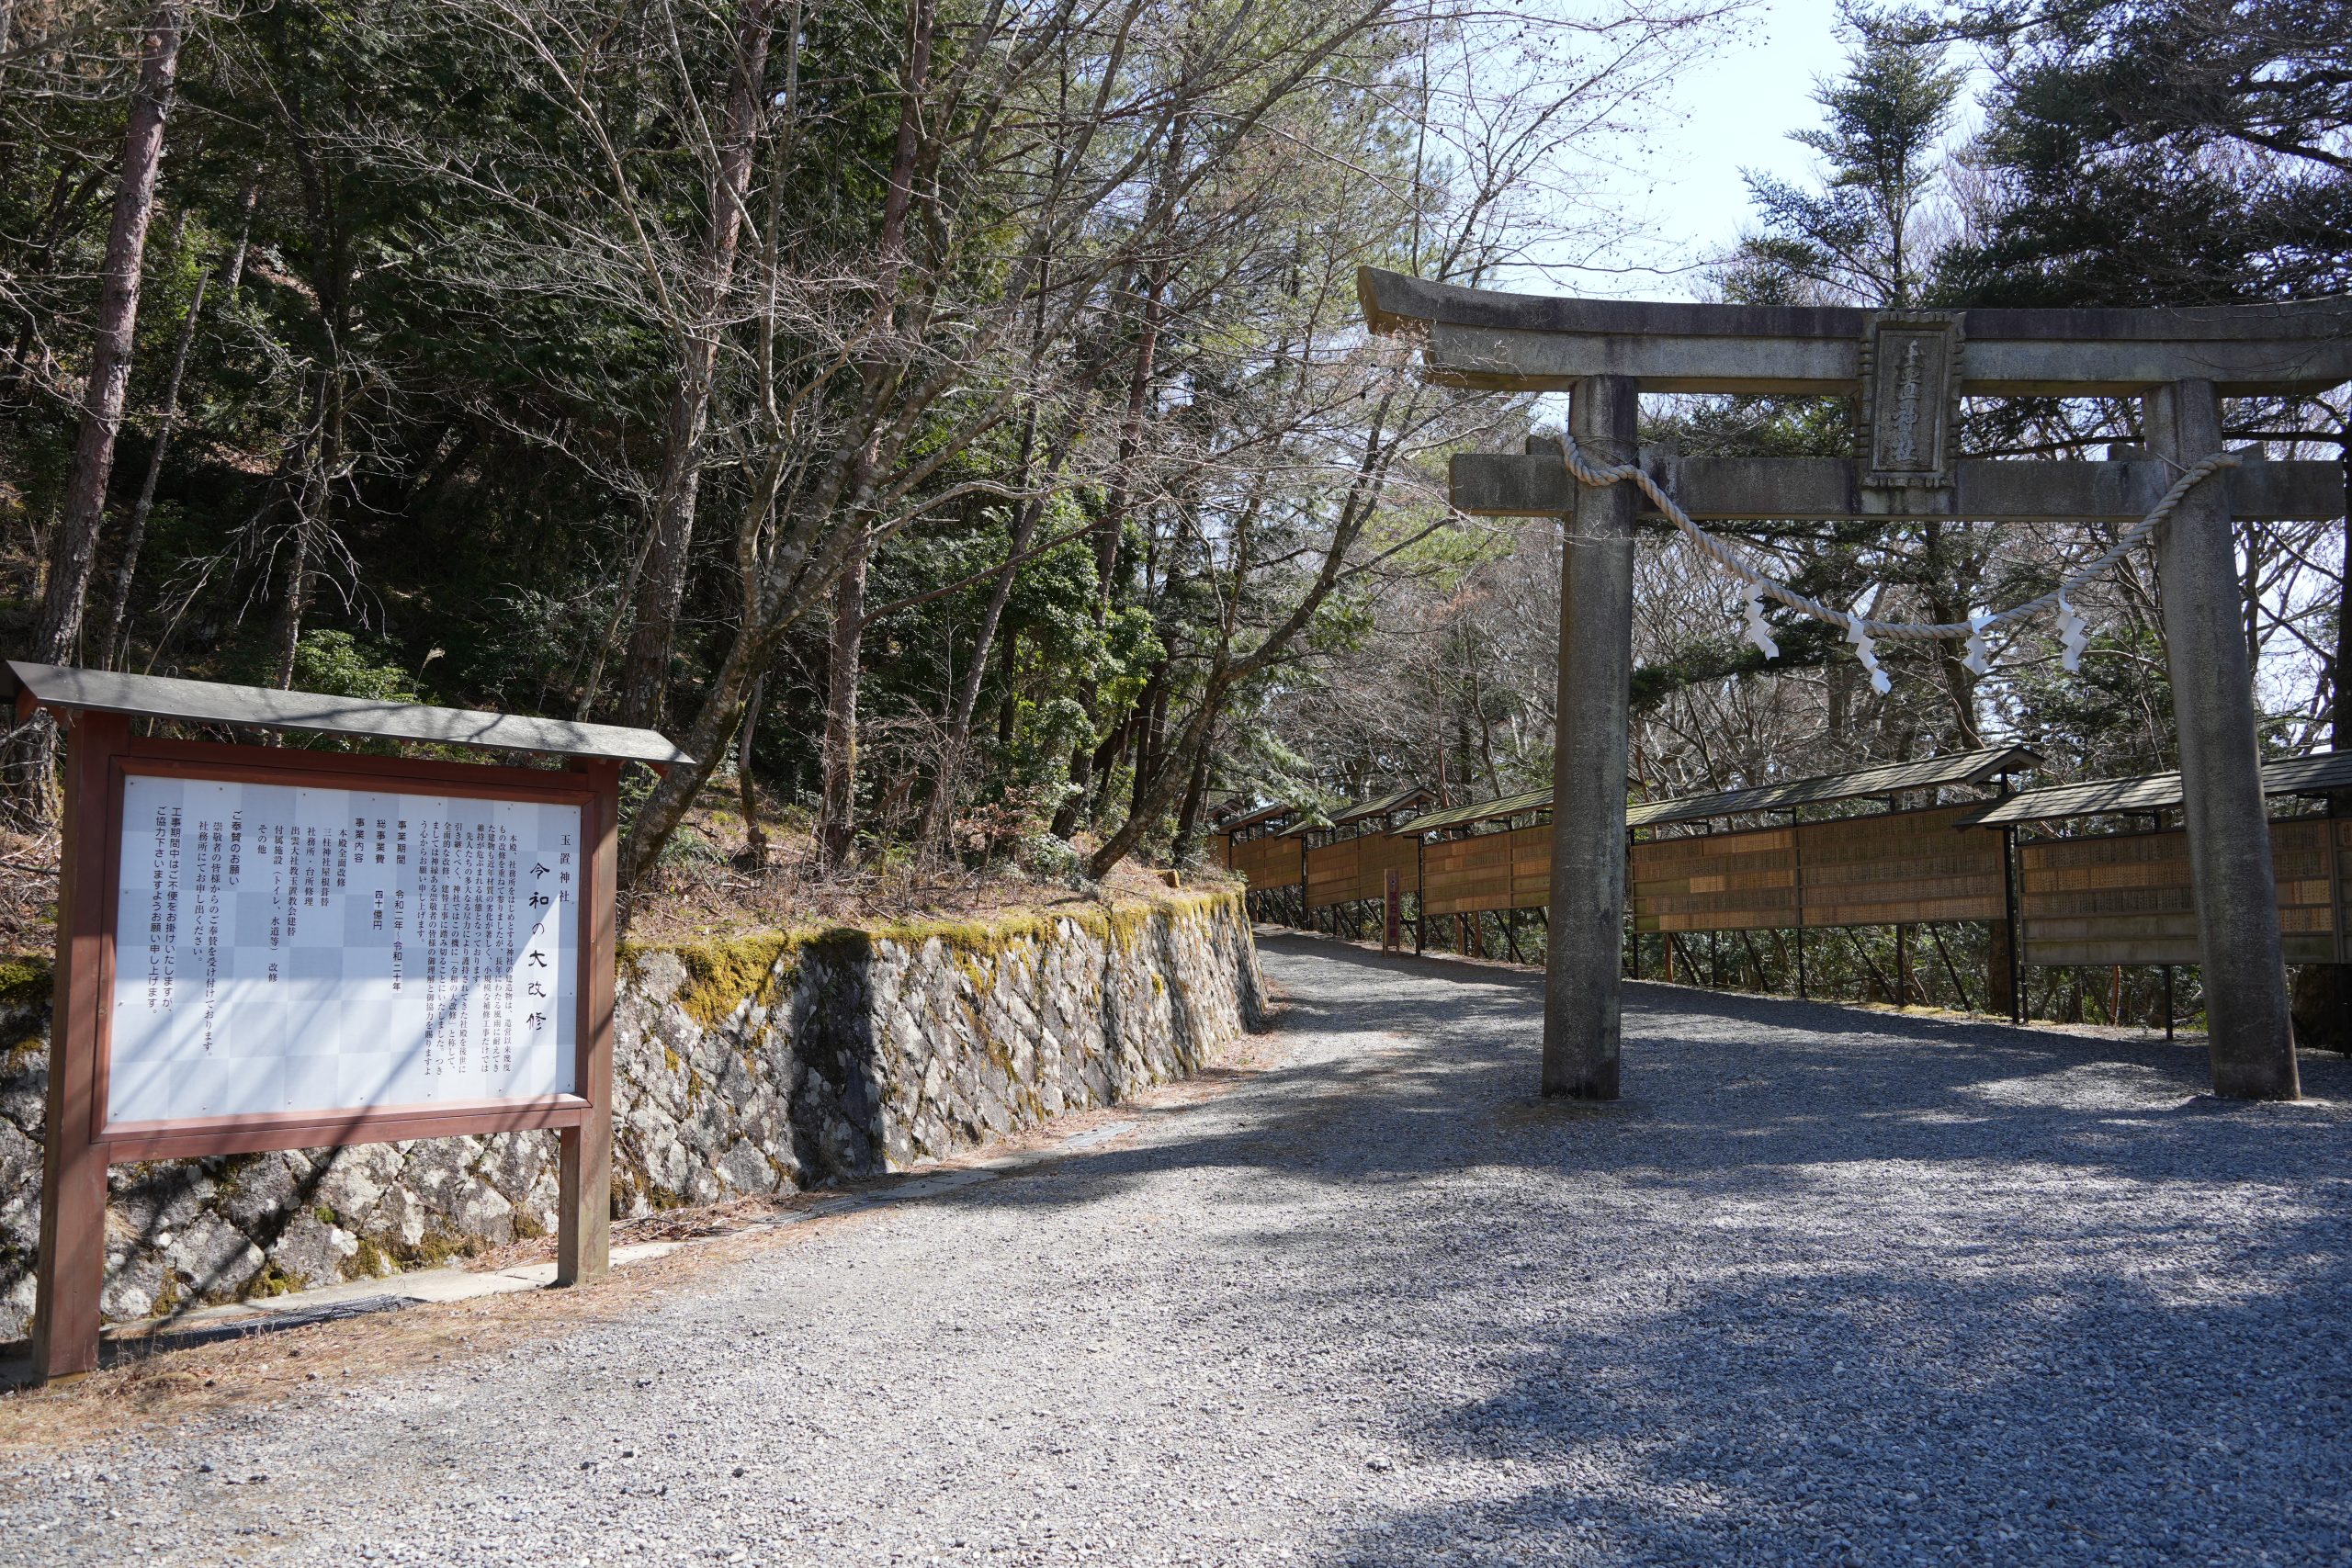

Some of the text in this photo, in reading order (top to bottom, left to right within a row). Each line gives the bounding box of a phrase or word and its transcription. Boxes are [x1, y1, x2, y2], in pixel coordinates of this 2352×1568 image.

[193, 820, 209, 962] 社務所にてお申し出ください。
[229, 810, 243, 886] ご奉賛のお願い
[257, 825, 267, 854] その他
[287, 826, 300, 937] 出雲大社教玉置教会建替
[304, 827, 316, 907] 社務所・台所修理
[321, 828, 332, 907] 三柱神社屋根葺替
[336, 829, 347, 887] 本殿全面改修
[354, 818, 365, 863] 事業内容
[373, 819, 386, 931] 総事業費 四十億円
[396, 820, 407, 864] 事業期間
[416, 820, 428, 942] う心からお願い申し上げます。
[559, 834, 571, 902] 玉置神社
[148, 806, 167, 1014] ご協力下さいますようお願い申し上げます。
[163, 807, 182, 1013] 工事期間中はご不便をお掛けいたしますが、
[203, 821, 223, 1055] 崇敬者の皆様からのご奉賛を受け付けております。
[458, 831, 474, 1073] 先人たちの多大なる尽力により護持されてきた社殿を後世に
[472, 823, 485, 987] 維持が危ぶまれる状態となっております。
[481, 824, 496, 1072] た建物も近年材質の劣化が著しく、小規模な補修工事だけでは
[492, 825, 506, 1072] もの改修を重ねて参りましたが、長年にわたる風雨に耐えてき
[526, 862, 550, 1031] 令和の大改修
[268, 963, 277, 983] 改修
